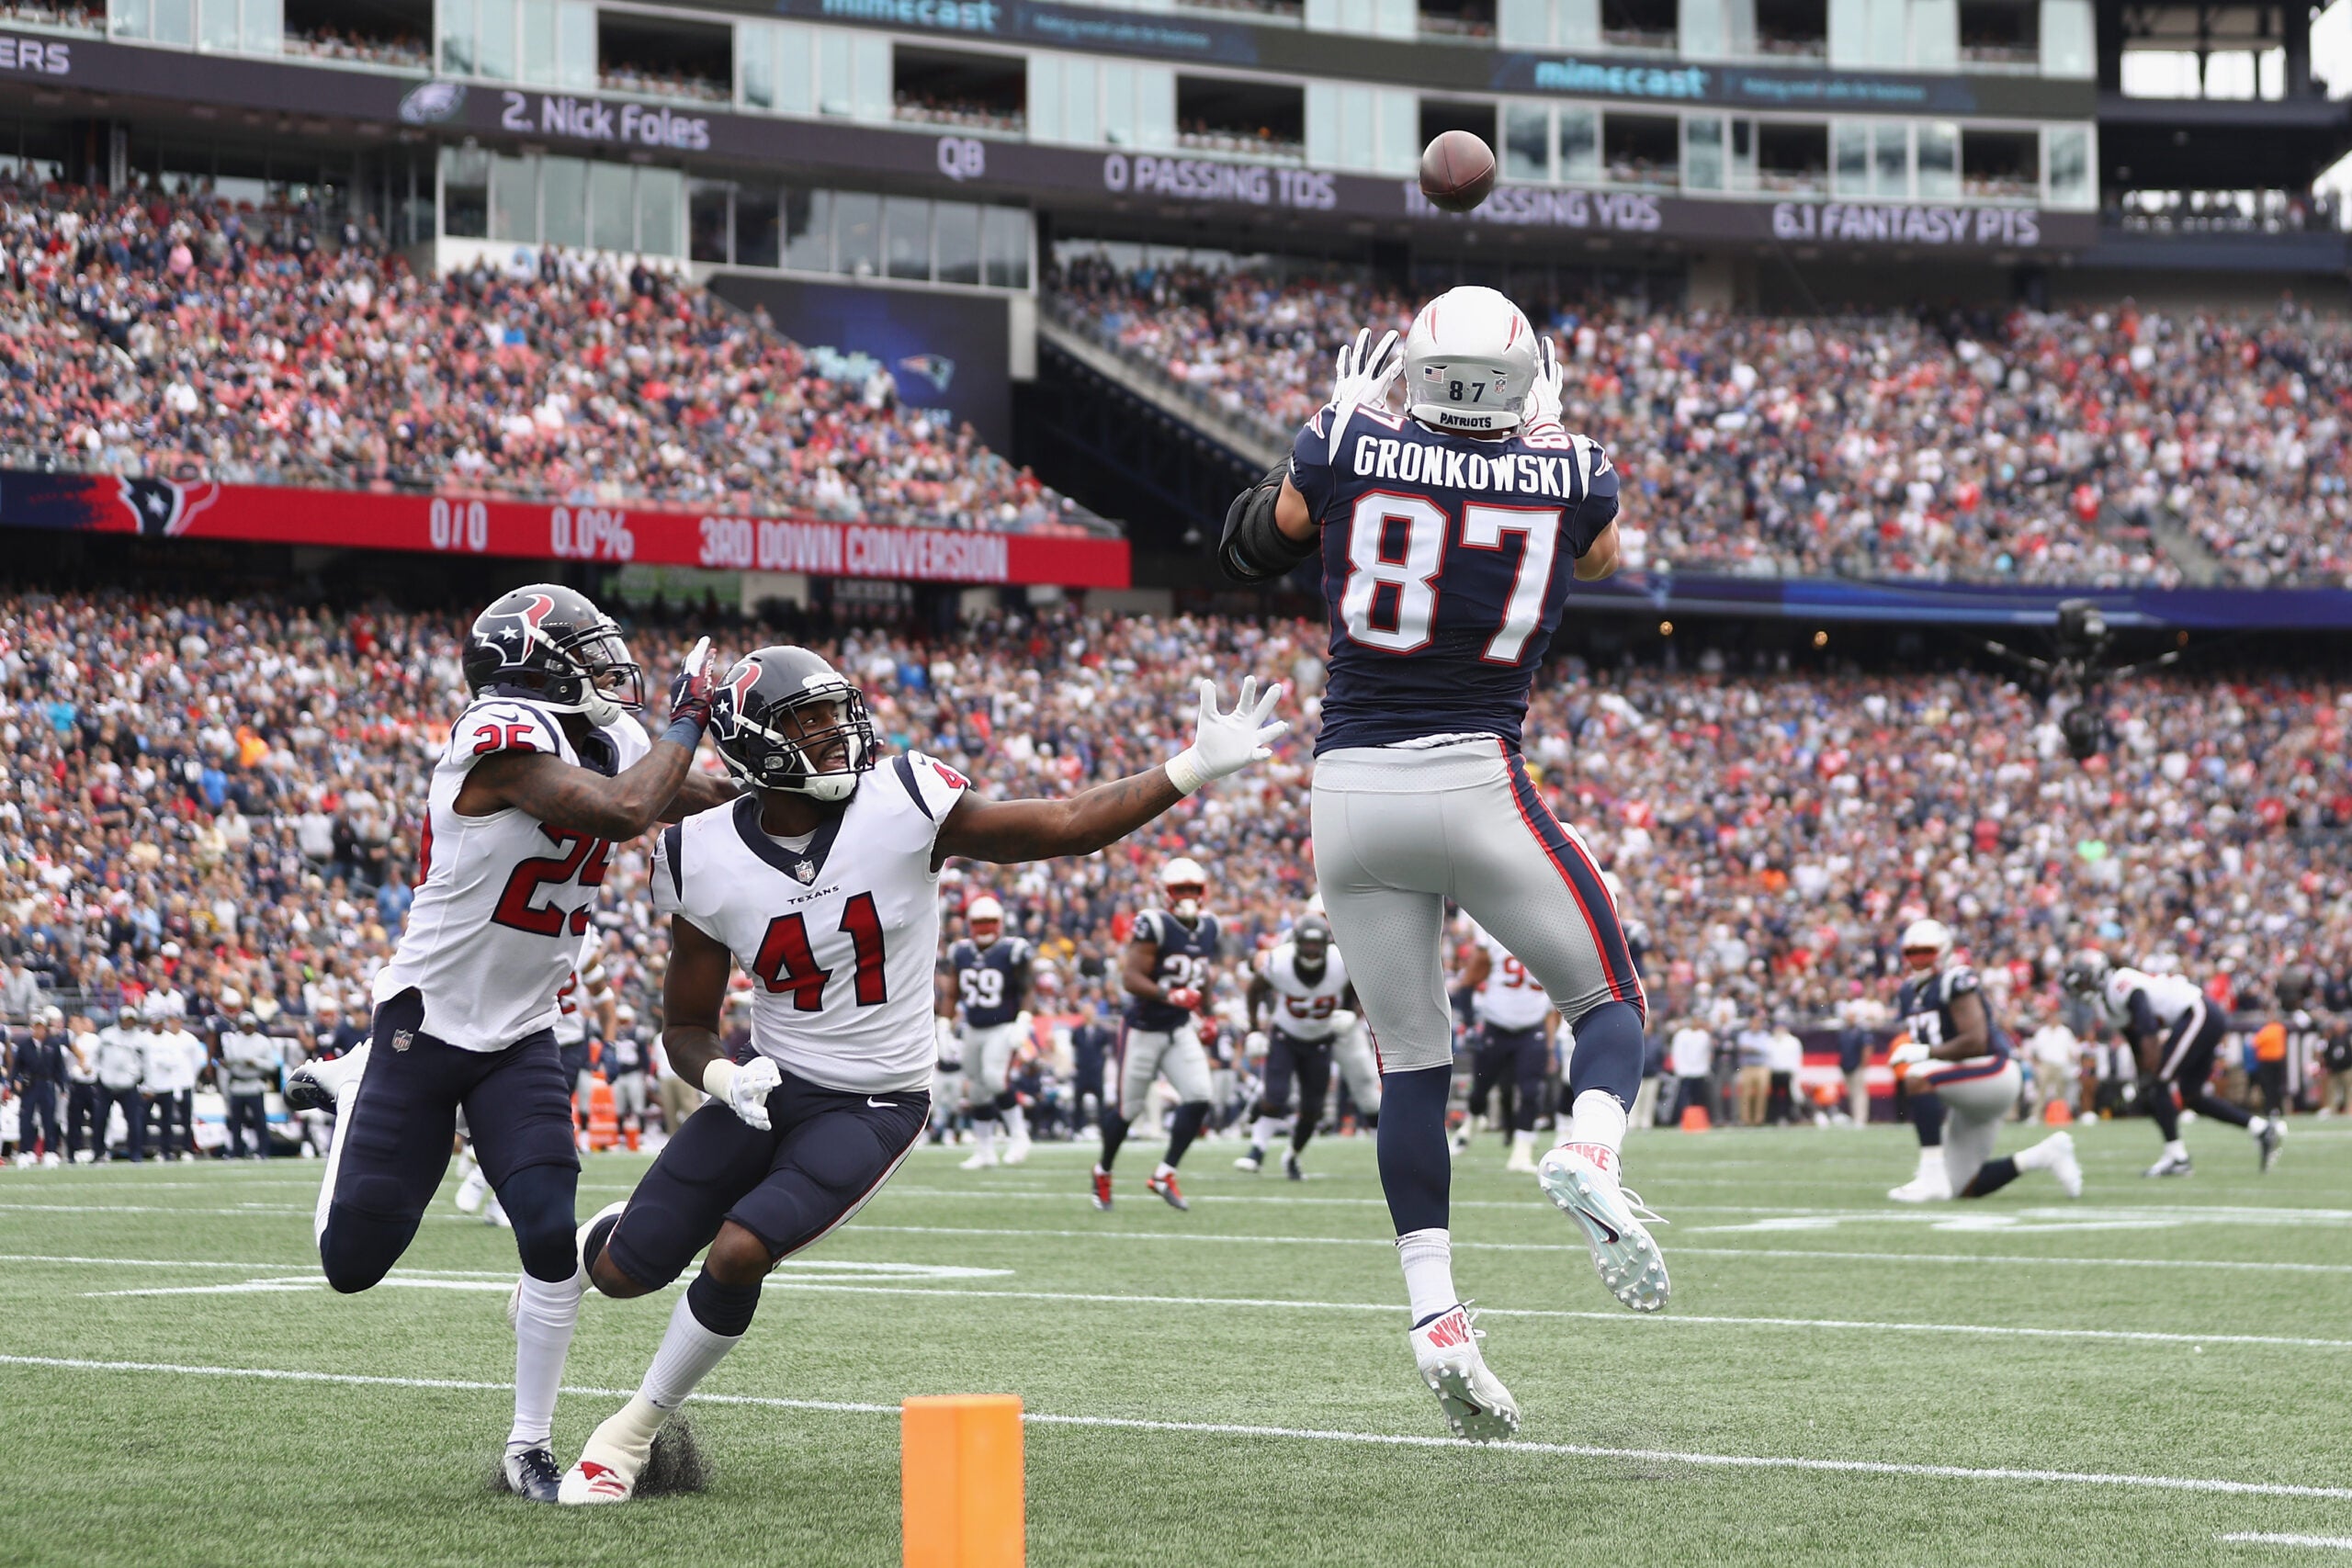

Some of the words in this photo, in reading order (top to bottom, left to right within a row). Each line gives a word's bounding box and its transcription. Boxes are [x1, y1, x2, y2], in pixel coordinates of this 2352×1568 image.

[0, 37, 71, 74] ERS
[1535, 58, 1706, 98] mimecast
[541, 95, 615, 140] Nick
[621, 103, 711, 151] Foles
[937, 136, 985, 181] QB
[1134, 155, 1270, 205] PASSING
[1274, 167, 1337, 210] TDS
[1594, 191, 1662, 231] YDS
[1821, 203, 1972, 244] FANTASY
[1976, 208, 2041, 247] PTS
[1449, 380, 1486, 402] 87
[1440, 412, 1492, 428] PATRIOTS
[1353, 434, 1571, 499] GRONKOWSKI
[430, 497, 488, 552] 0/0
[552, 505, 634, 561] 0.0%
[699, 516, 753, 568] 3RD
[758, 519, 842, 573] DOWN
[846, 525, 1008, 582] CONVERSION
[1338, 488, 1565, 667] 87
[786, 885, 840, 905] TEXANS
[752, 890, 888, 1011] 41
[1427, 1312, 1470, 1348] NIKE
